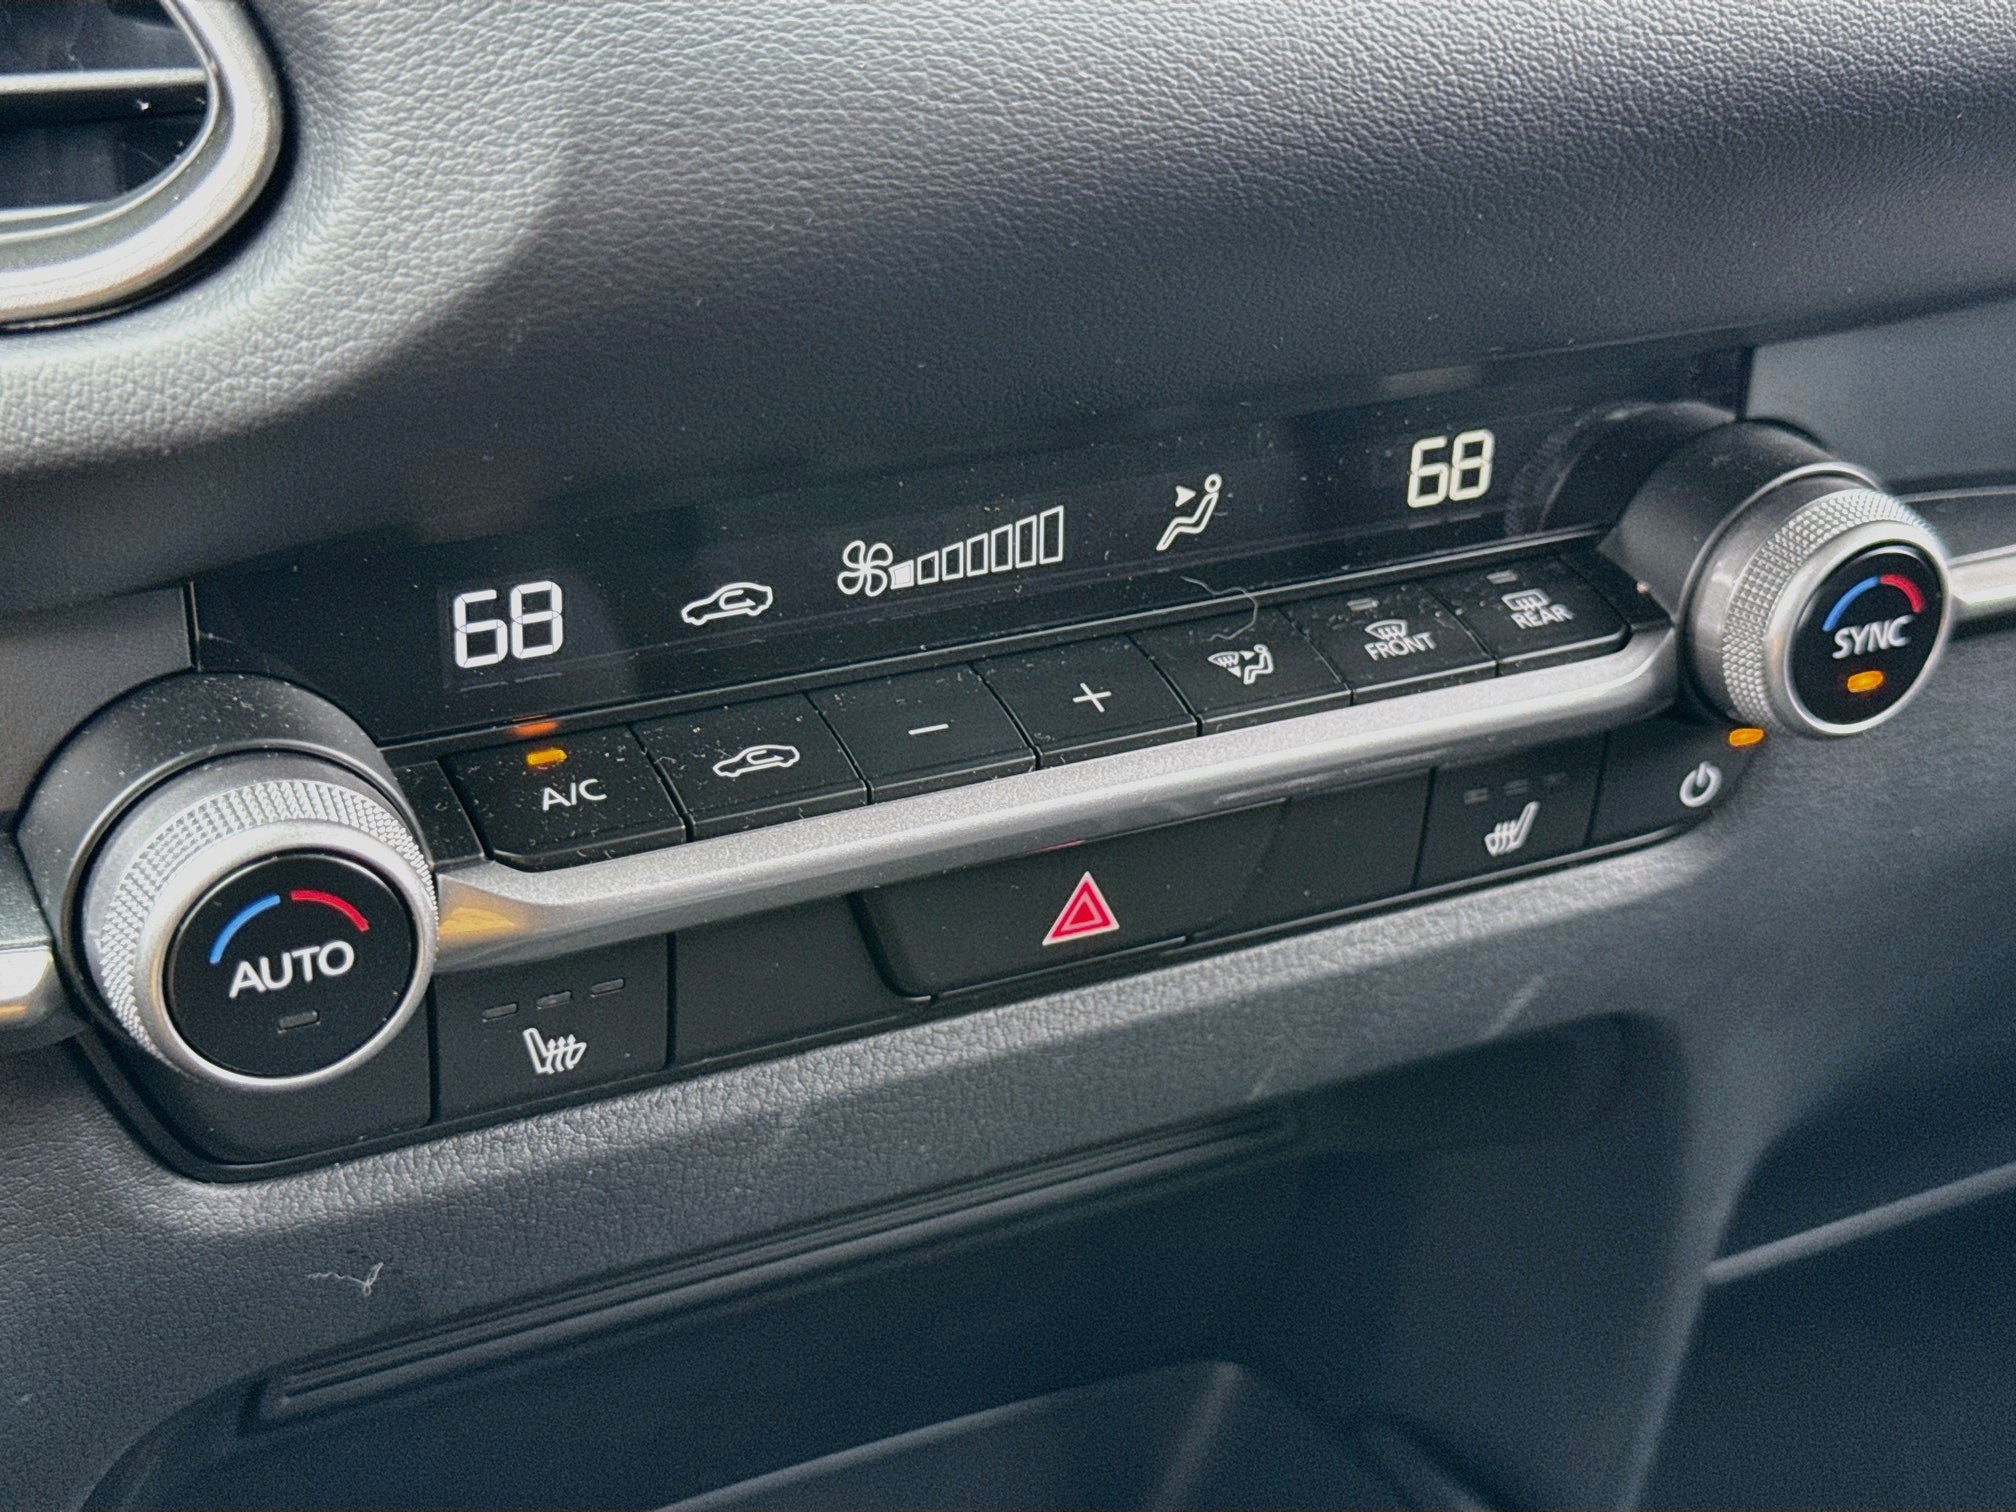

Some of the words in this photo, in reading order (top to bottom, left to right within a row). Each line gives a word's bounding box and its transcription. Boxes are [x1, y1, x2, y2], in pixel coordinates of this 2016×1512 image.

[1407, 428, 1495, 508] 68
[453, 580, 564, 669] 68
[1510, 602, 1573, 630] REAR
[1832, 614, 1911, 660] SYNC
[1364, 631, 1437, 661] FRONT
[541, 777, 607, 812] A/C
[228, 939, 355, 999] AUTO
